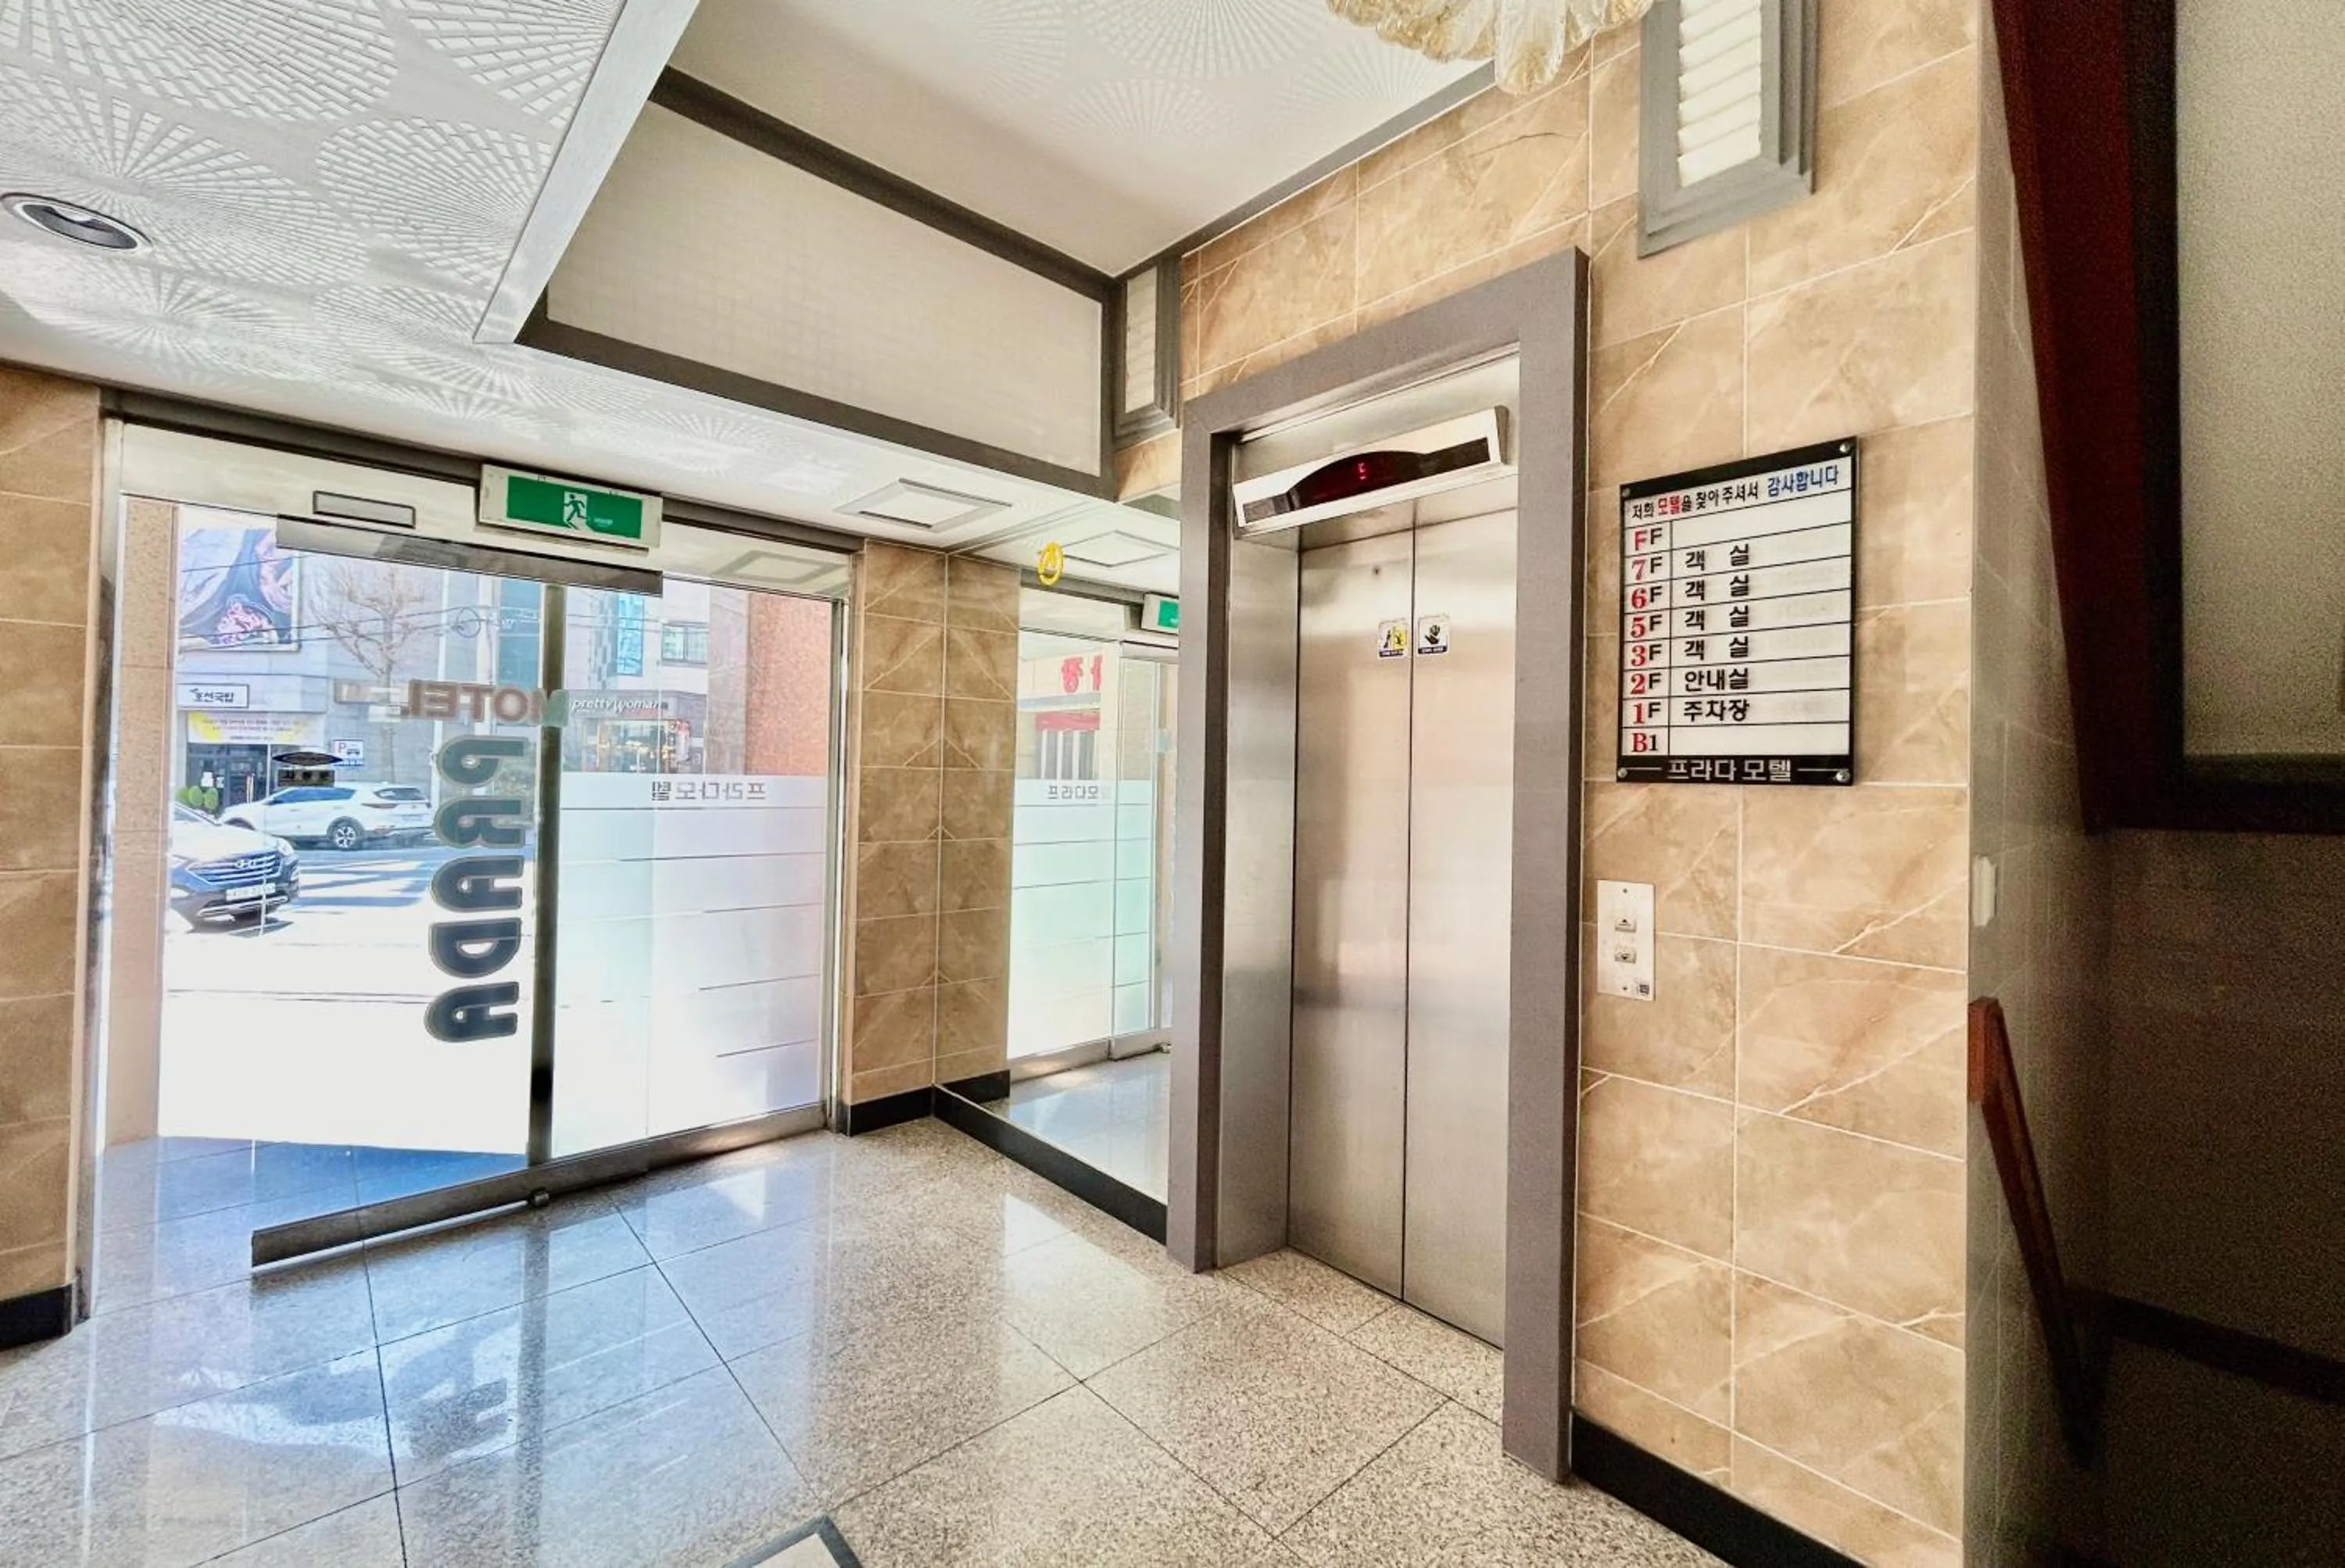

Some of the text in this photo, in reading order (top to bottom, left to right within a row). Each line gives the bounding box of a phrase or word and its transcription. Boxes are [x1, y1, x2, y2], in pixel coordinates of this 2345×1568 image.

[1632, 465, 1839, 519] 저희 모텔을 찾아 주셔서 감사합니다
[1634, 527, 1663, 551] FF
[1631, 557, 1663, 581] 7F
[1631, 586, 1663, 610] 6F
[1631, 614, 1663, 639] 5F
[1631, 644, 1663, 667] 3F
[1631, 668, 1749, 695] 2F 안내실
[1632, 699, 1750, 725] 1F 주차장
[1631, 733, 1659, 753] B1
[1667, 759, 1792, 782] 프라다 모텔
[1047, 785, 1112, 800] 프라다모
